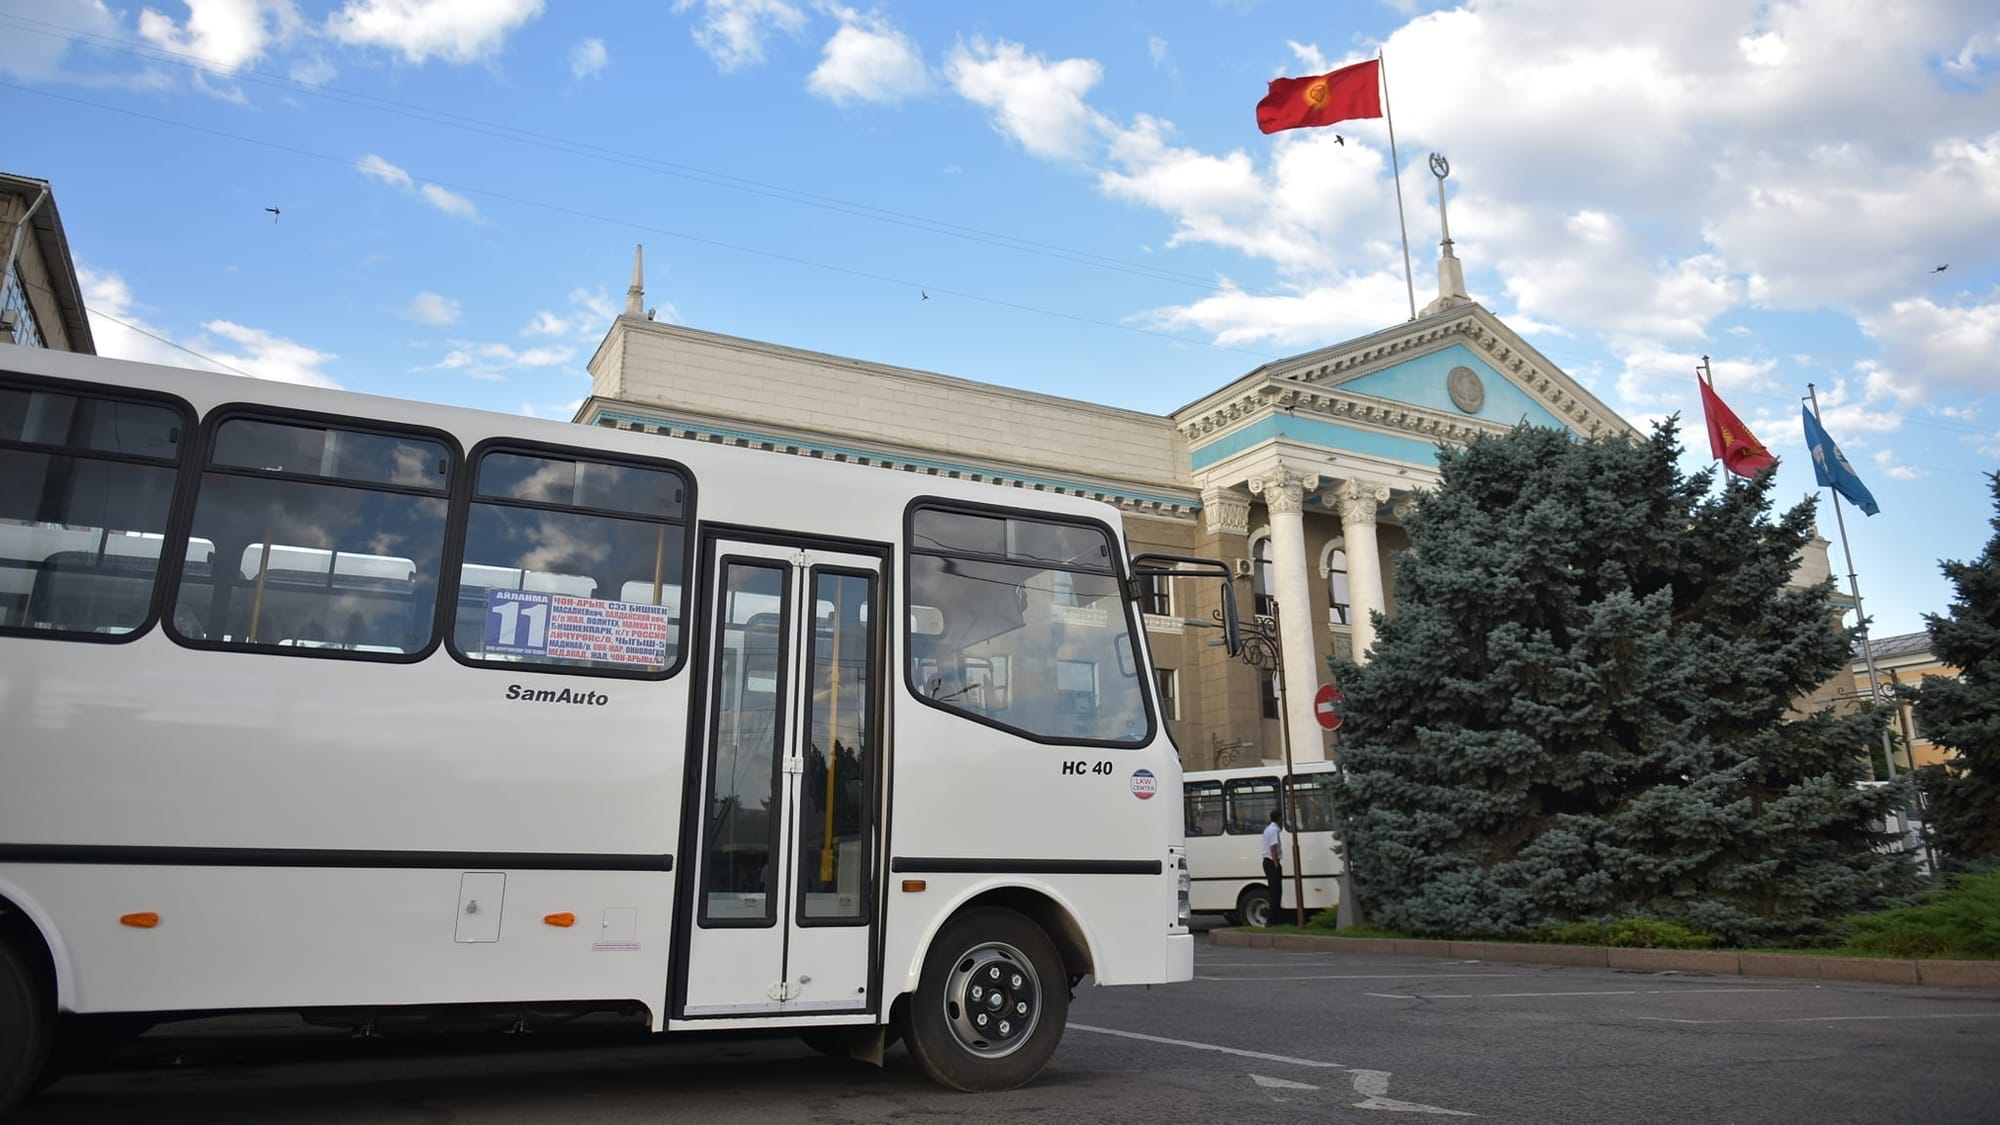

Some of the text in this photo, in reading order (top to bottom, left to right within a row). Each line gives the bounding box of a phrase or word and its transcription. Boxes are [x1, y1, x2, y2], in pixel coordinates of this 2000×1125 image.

[496, 591, 548, 603] АЙЛАНМА
[608, 601, 627, 611] СЭЗ
[628, 604, 668, 615] БИШКЕК
[492, 602, 547, 648] 11
[631, 629, 666, 640] РОССИЯ
[505, 684, 609, 706] SamAuto
[1062, 761, 1113, 775] HC 40
